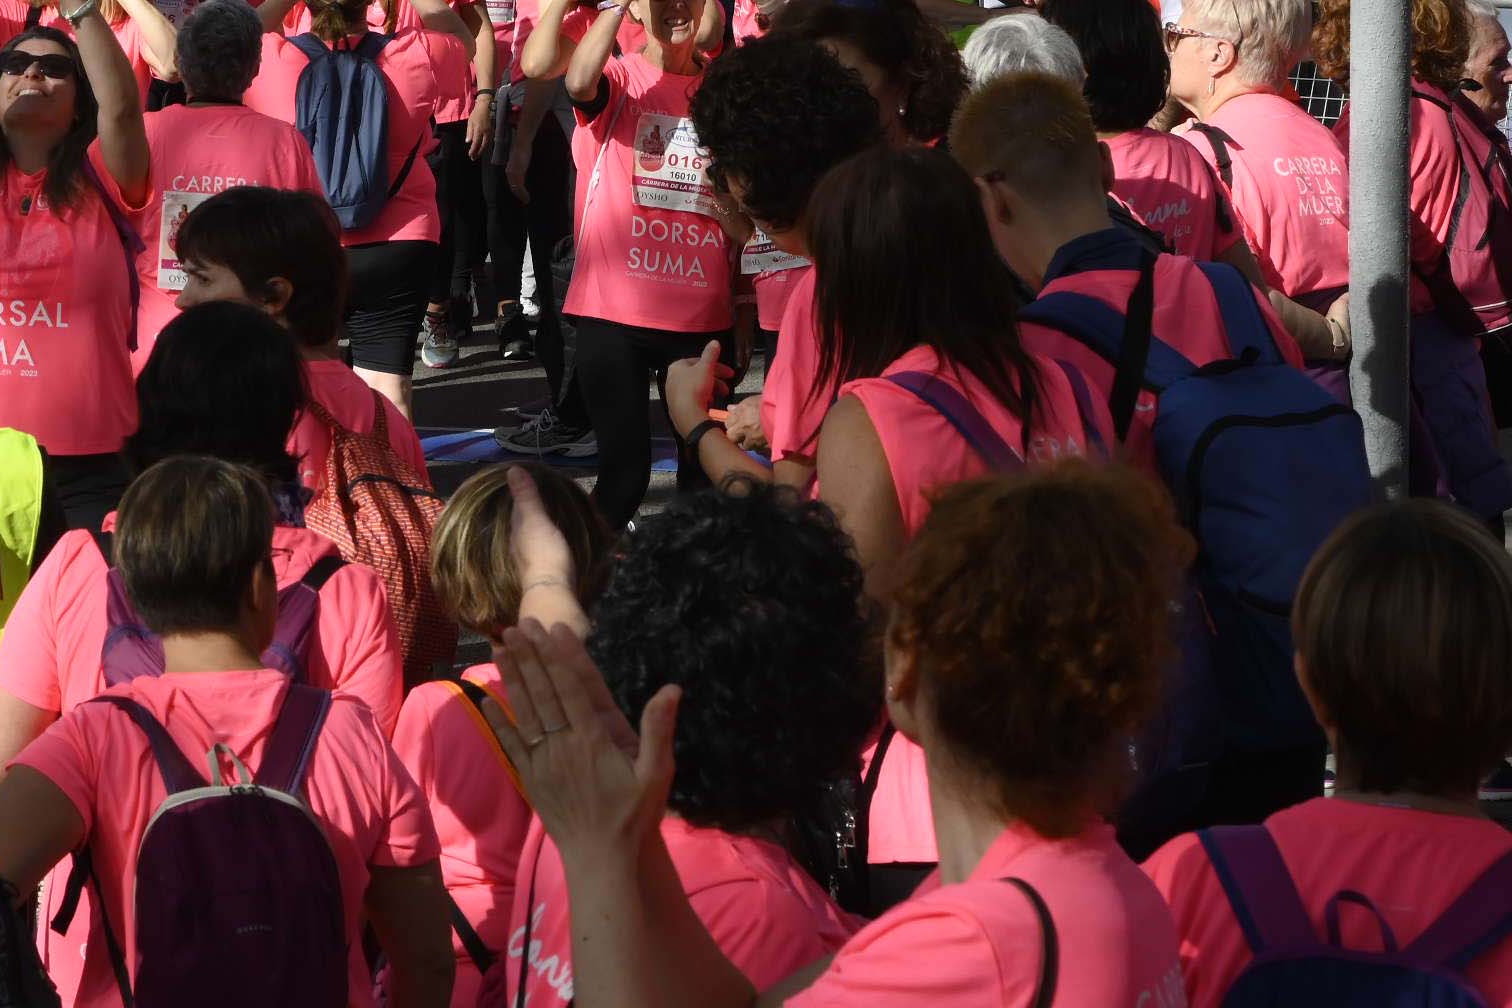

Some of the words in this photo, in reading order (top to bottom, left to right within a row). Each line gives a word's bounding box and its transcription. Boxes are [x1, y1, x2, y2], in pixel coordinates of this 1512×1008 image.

[667, 153, 703, 170] 016
[1273, 156, 1342, 176] CARRERA
[669, 171, 697, 182] 16010
[1296, 176, 1312, 194] DE
[1319, 178, 1337, 194] LA
[627, 247, 705, 279] SUMA
[168, 273, 188, 284] OYS
